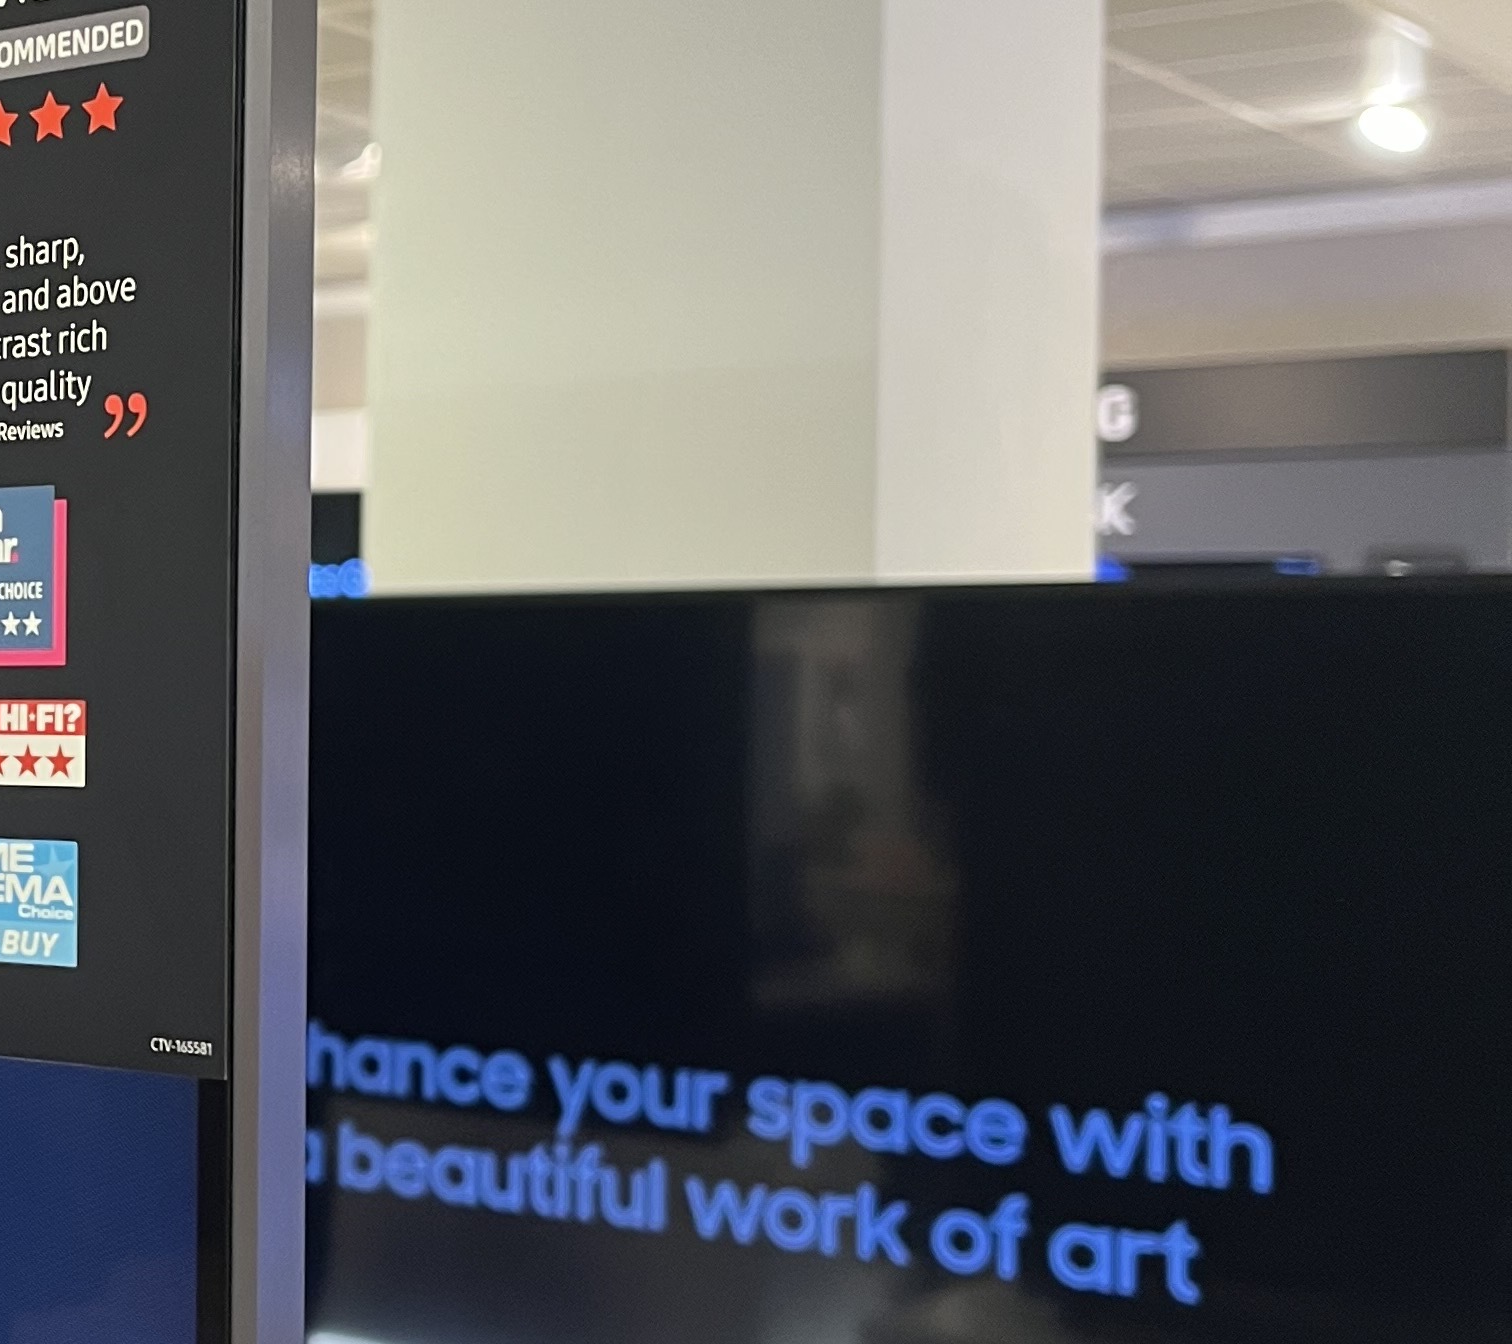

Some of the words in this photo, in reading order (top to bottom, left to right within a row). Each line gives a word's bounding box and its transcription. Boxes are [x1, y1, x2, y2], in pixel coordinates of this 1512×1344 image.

[5, 235, 85, 269] sharp,
[2, 278, 50, 314] and
[56, 274, 137, 309] above
[58, 319, 108, 355] rich
[1, 369, 92, 411] quality
[17, 904, 74, 920] Choice
[0, 930, 60, 957] BUY
[150, 1037, 212, 1056] CTV-165581
[548, 1056, 728, 1140] your
[745, 1075, 1029, 1167] space
[1049, 1091, 1274, 1195] with
[337, 1119, 669, 1233] beautiful
[685, 1174, 911, 1268] work
[929, 1191, 1031, 1282] of
[1046, 1220, 1201, 1306] art
